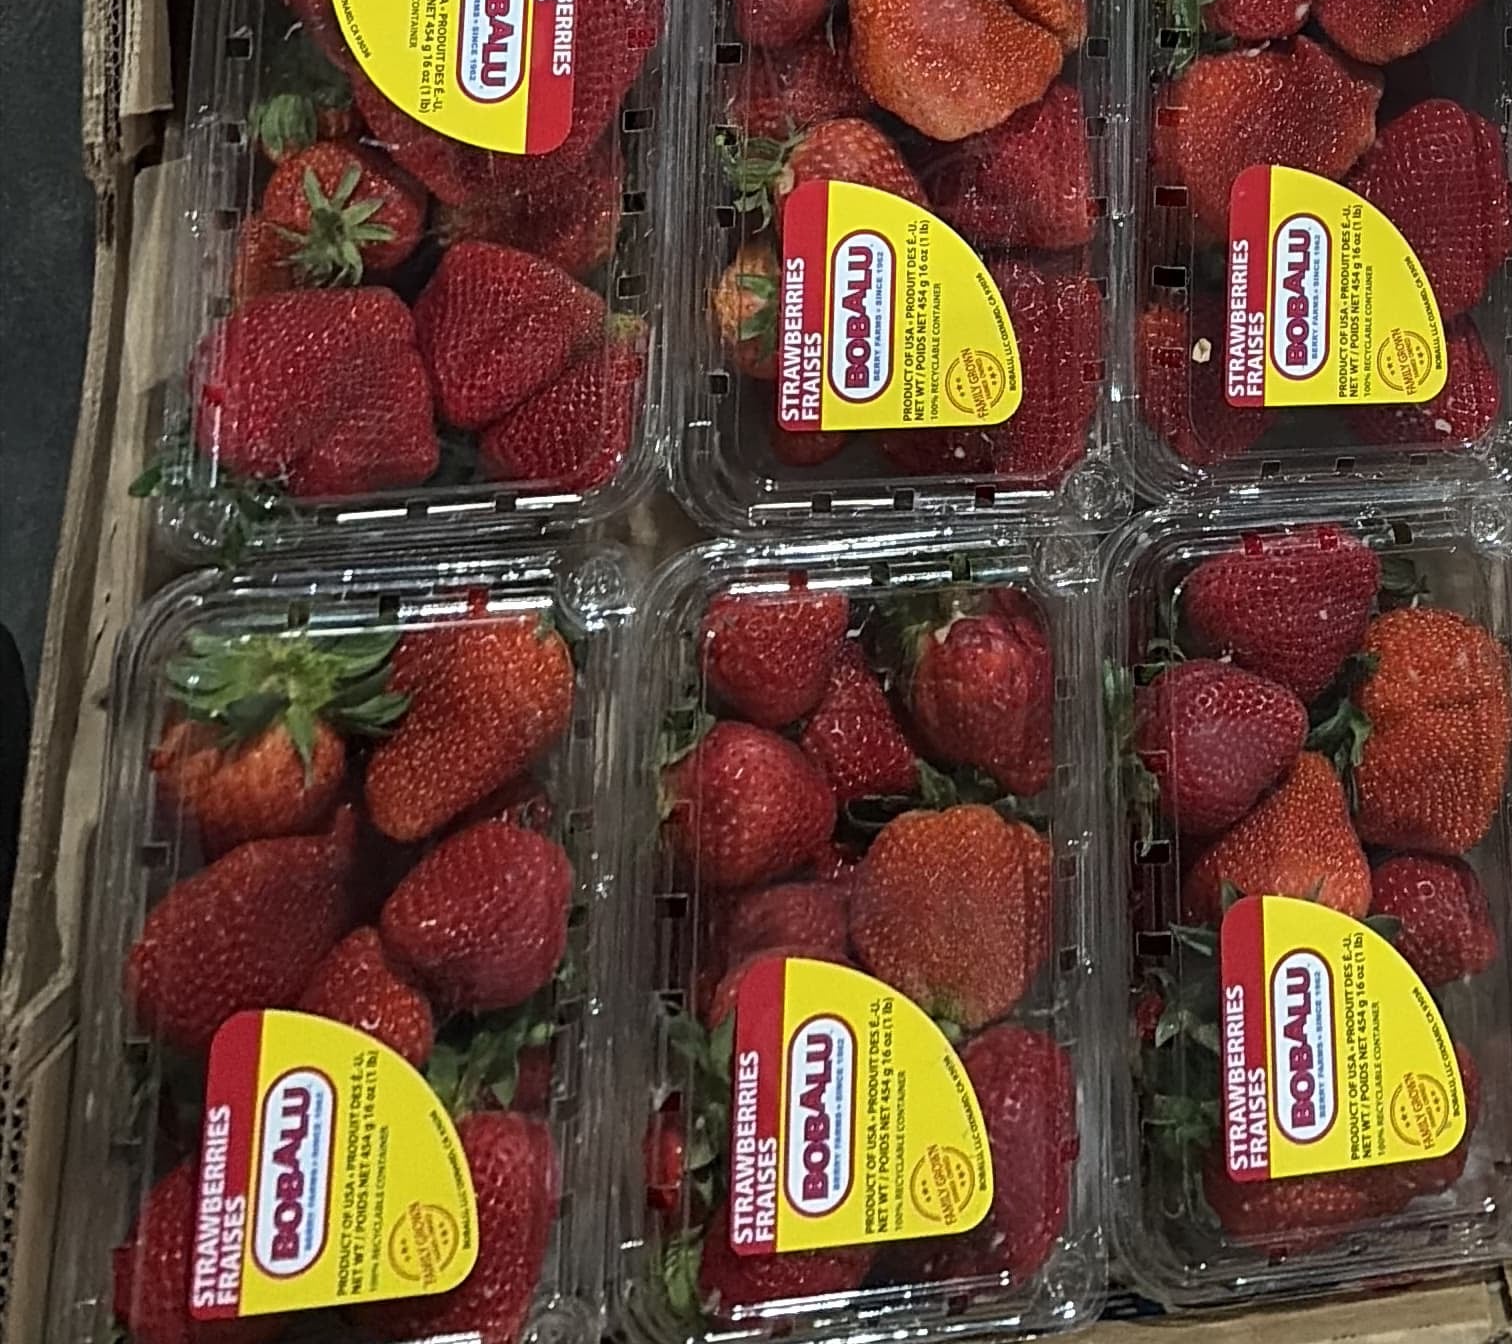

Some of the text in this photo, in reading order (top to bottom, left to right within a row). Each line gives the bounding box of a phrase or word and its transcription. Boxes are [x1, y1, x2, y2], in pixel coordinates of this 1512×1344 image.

[919, 220, 931, 234] lb)
[919, 237, 930, 246] (1
[907, 247, 916, 267] DES
[919, 264, 927, 276] 16
[921, 249, 928, 261] oz
[842, 246, 873, 388] BOBALU
[905, 271, 915, 317] PRODUIT
[917, 289, 927, 309] 454
[932, 283, 940, 334] CONTAINER
[987, 294, 999, 307] CA
[1228, 239, 1248, 396] STRAWBERRIES
[1283, 229, 1310, 365] BOBALU
[781, 257, 804, 420] STRAWBERRIES
[904, 327, 914, 348] USA
[918, 312, 926, 333] NET
[1002, 340, 1012, 355] LLC
[802, 332, 821, 419] FRAISES
[904, 351, 913, 365] OF
[916, 336, 926, 369] POIDS
[930, 337, 939, 392] RECYCLABLE
[960, 347, 978, 383] GROWN
[1246, 311, 1264, 395] FRAISES
[903, 368, 913, 420] PRODUCT
[915, 399, 924, 420] NET
[916, 379, 925, 396] WT
[970, 384, 988, 417] FAMILY
[1283, 966, 1314, 1128] BOBALU
[1226, 984, 1248, 1170] STRAWBERRIES
[799, 1032, 832, 1200] BOBALU
[1248, 1067, 1267, 1168] FRAISES
[733, 1050, 759, 1243] STRAWBERRIES
[271, 1086, 311, 1261] BOBALU
[755, 1137, 776, 1241] FRAISES
[193, 1105, 230, 1307] STRAWBERRIES
[217, 1195, 245, 1304] FRAISES
